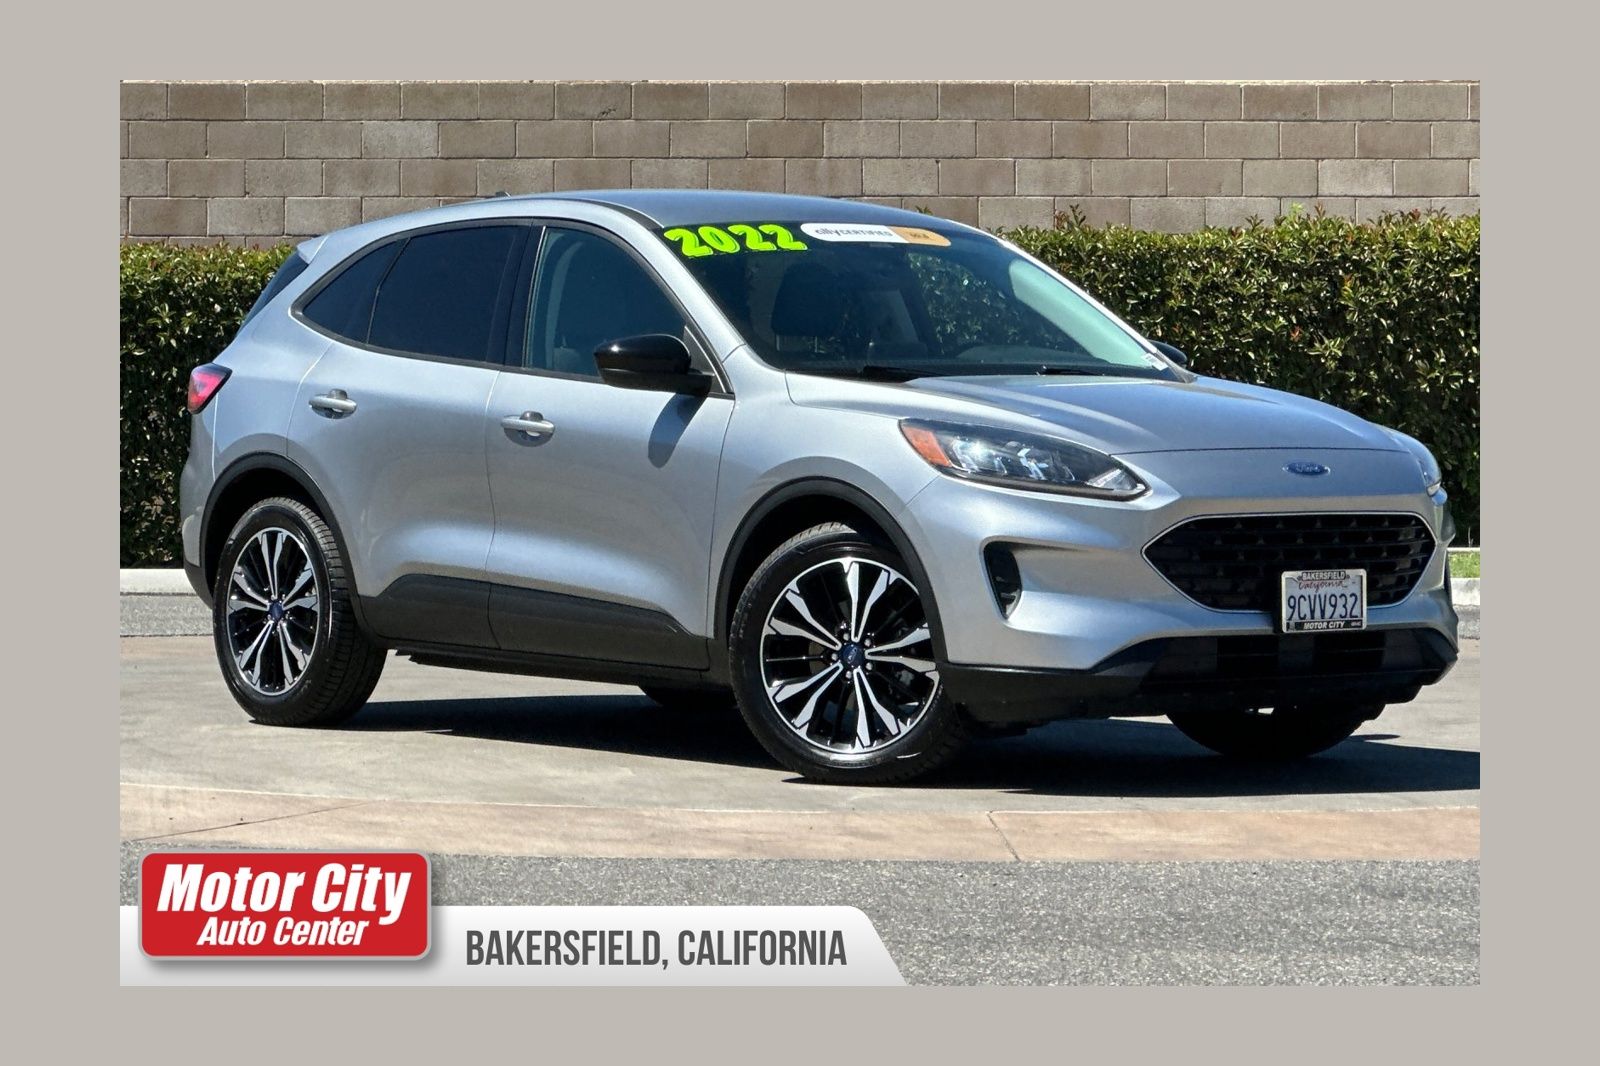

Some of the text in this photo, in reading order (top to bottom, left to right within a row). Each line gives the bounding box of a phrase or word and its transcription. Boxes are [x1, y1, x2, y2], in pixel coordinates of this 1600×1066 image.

[663, 224, 808, 257] 2022
[1302, 572, 1345, 580] BAKERSFIELD
[1288, 593, 1358, 621] 9CVV932
[1303, 620, 1346, 630] MOTOR CITY
